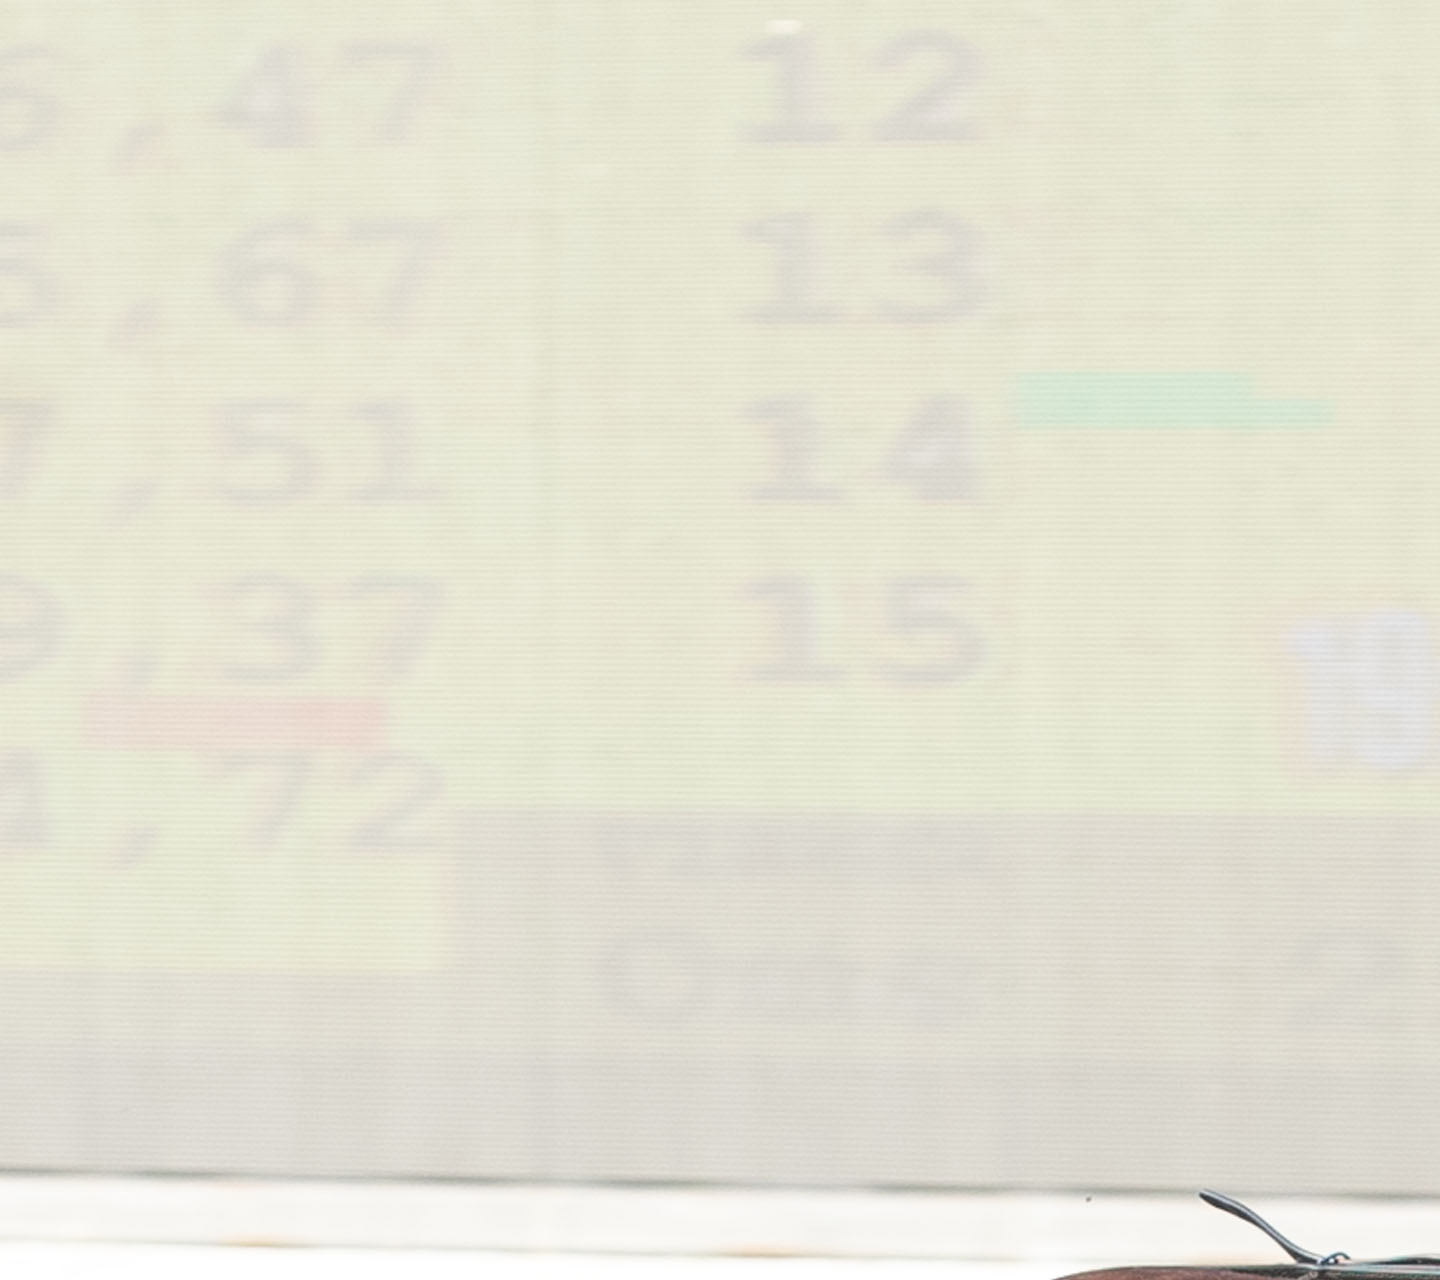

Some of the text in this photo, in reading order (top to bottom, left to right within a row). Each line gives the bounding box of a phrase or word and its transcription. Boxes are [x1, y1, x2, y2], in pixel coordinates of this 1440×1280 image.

[736, 28, 984, 146] 12
[738, 205, 994, 325] 13
[738, 397, 986, 504] 14
[738, 571, 990, 686] 15
